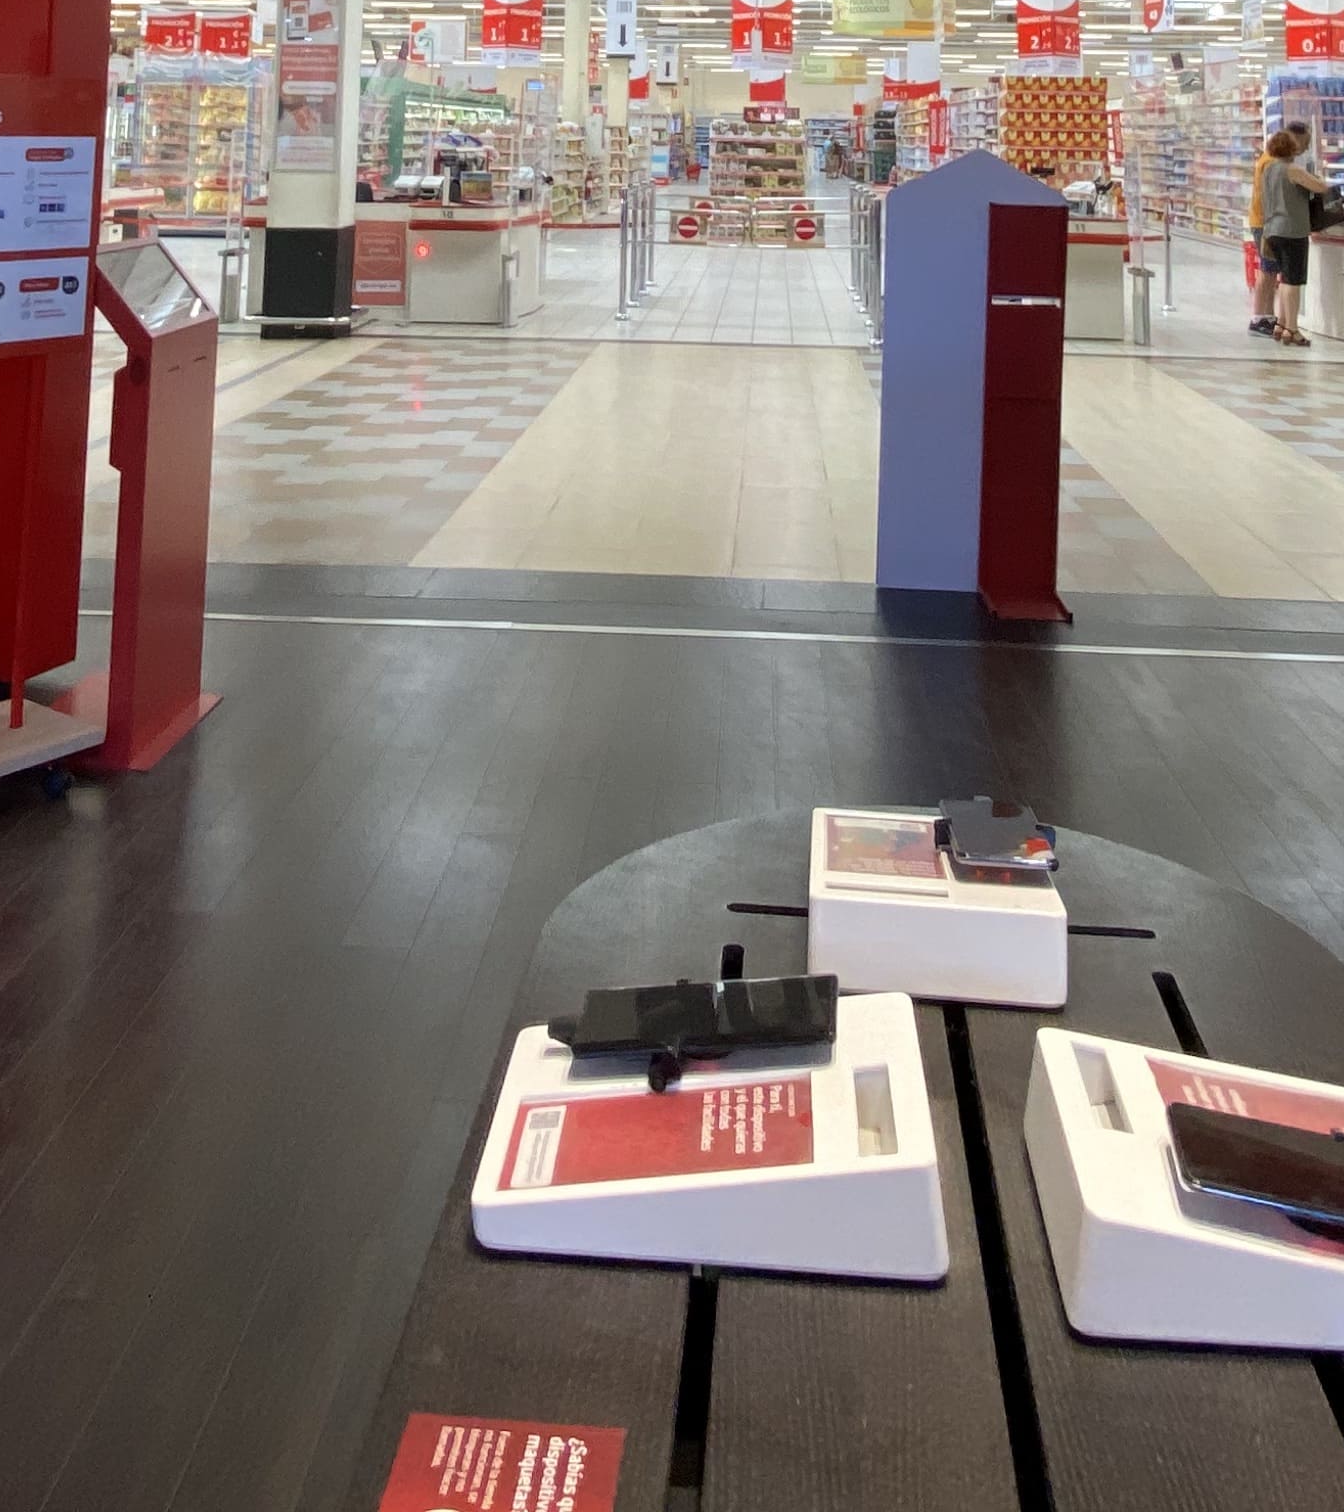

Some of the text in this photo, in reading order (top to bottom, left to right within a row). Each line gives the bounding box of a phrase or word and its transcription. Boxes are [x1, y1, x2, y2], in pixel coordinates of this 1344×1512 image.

[769, 1085, 782, 1103] Para
[701, 1104, 715, 1151] facilidades
[734, 1104, 747, 1120] que
[750, 1086, 765, 1152] este dispositivo
[734, 1120, 748, 1154] quieras
[495, 1431, 511, 1456] Fuera
[492, 1456, 503, 1468] de
[564, 1437, 588, 1495] ¿Sabías
[481, 1479, 497, 1510] tienda
